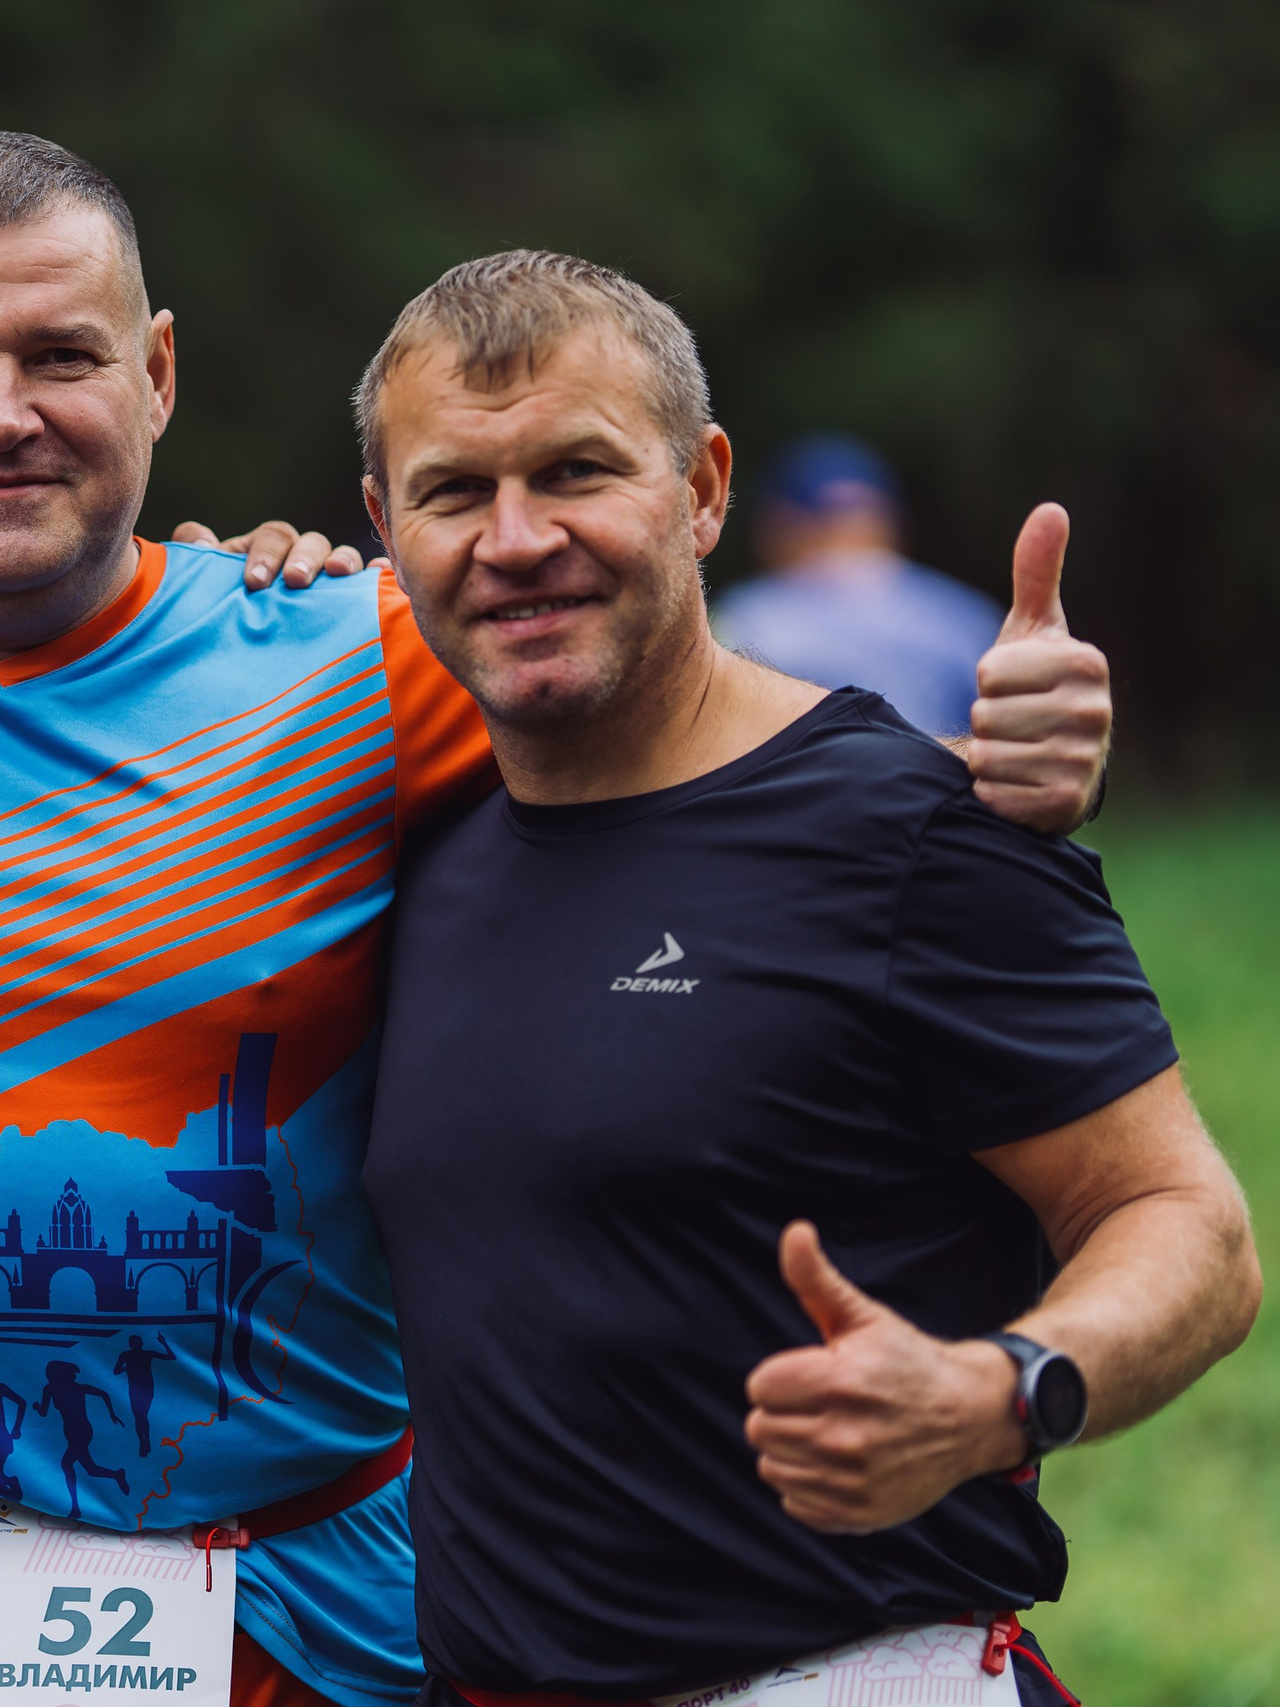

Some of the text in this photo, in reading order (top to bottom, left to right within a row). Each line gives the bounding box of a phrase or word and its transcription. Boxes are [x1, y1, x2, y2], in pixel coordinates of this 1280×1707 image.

[610, 977, 700, 994] DEMIX
[37, 1586, 154, 1657] 52
[728, 1677, 752, 1695] 40
